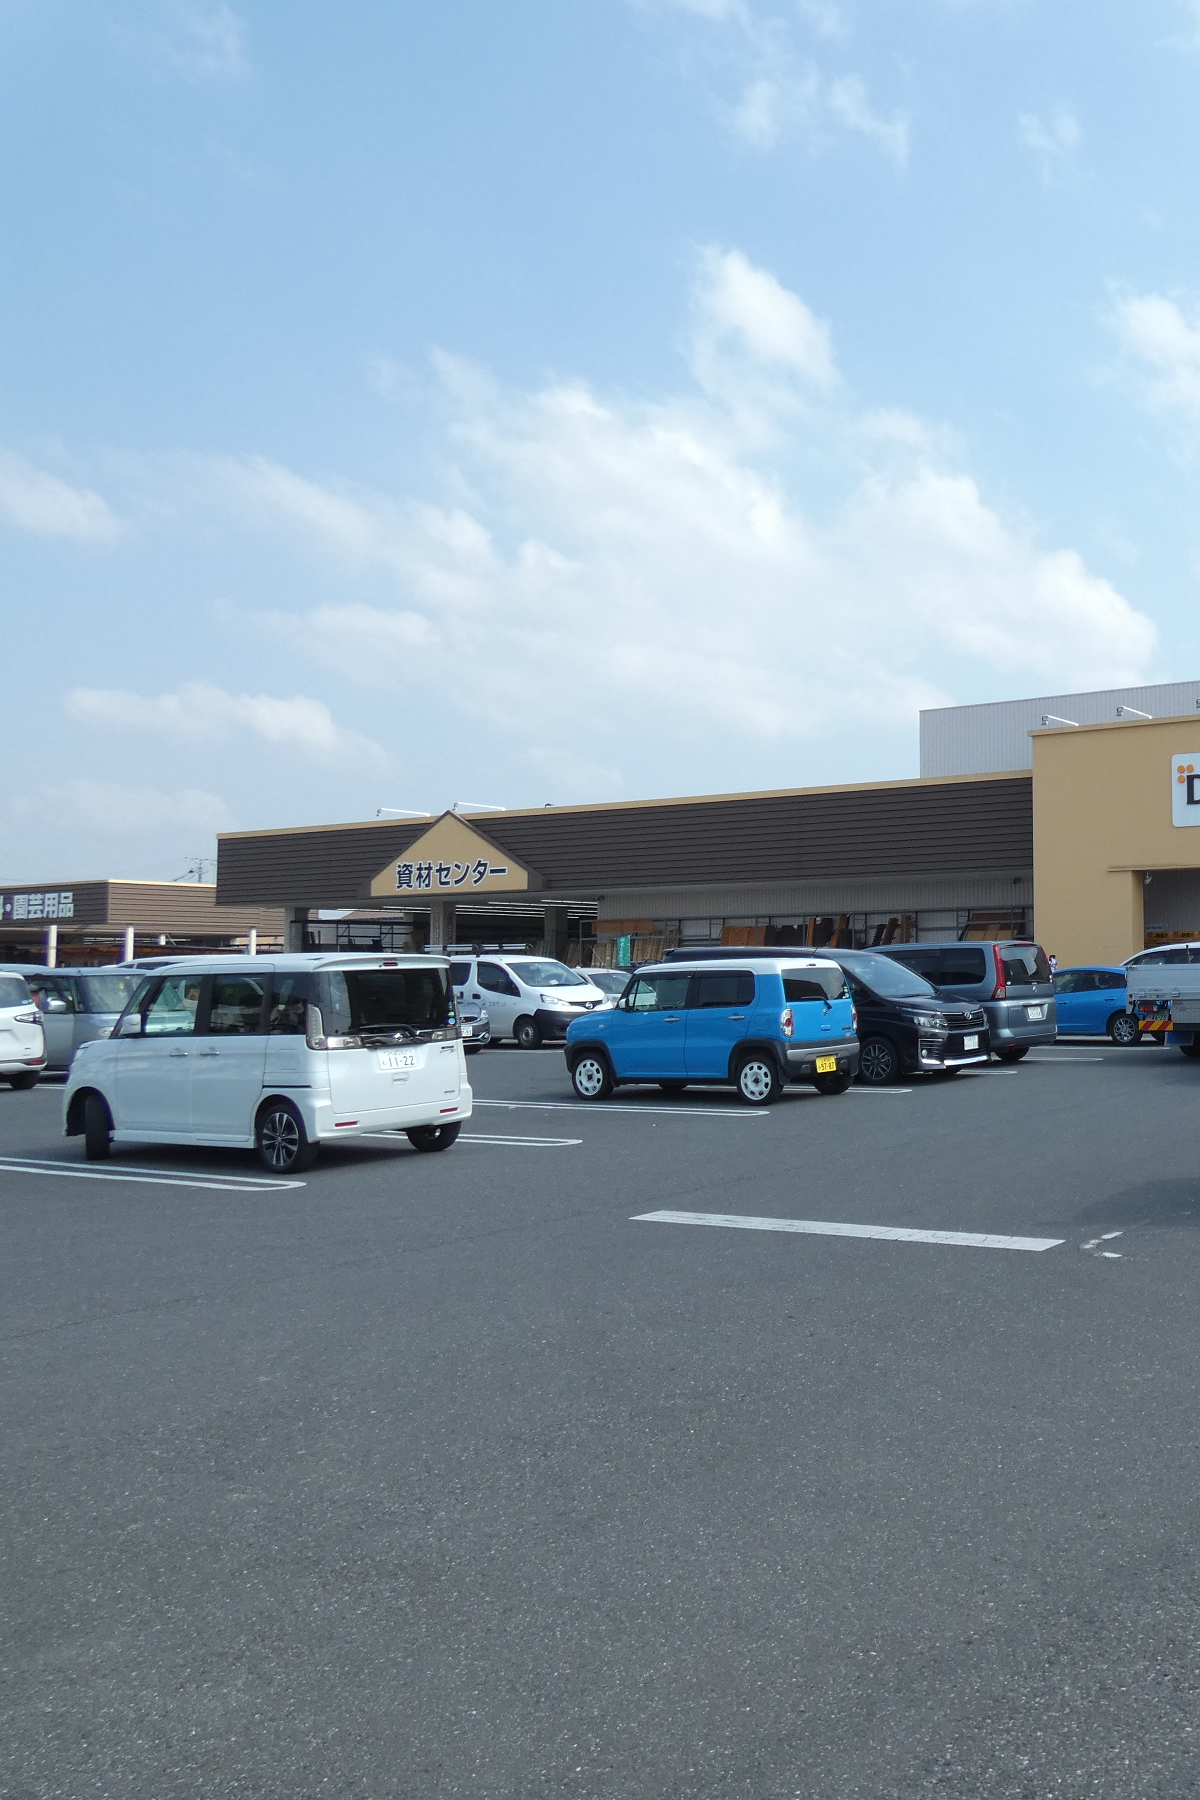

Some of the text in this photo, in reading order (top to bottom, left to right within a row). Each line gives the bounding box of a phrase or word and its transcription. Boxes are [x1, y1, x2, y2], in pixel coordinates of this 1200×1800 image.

[395, 858, 508, 890] 資材センター
[0, 892, 74, 920] ・園芸用品
